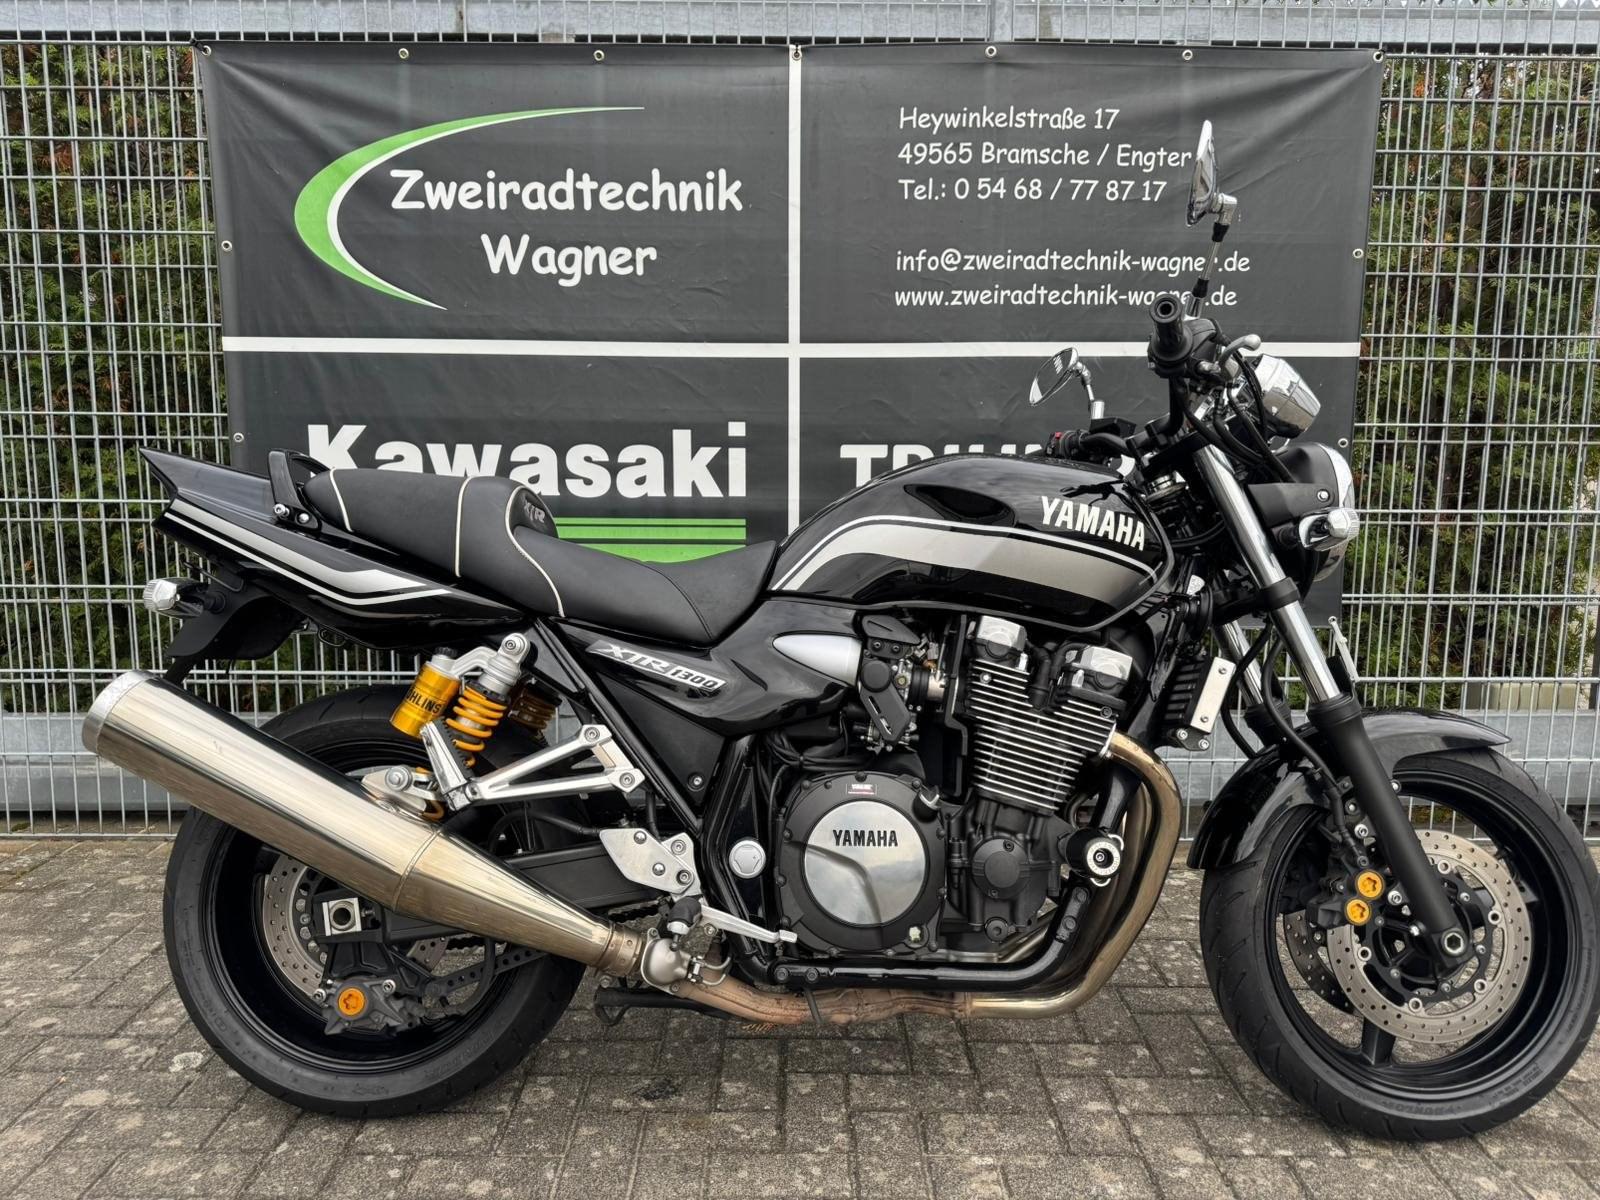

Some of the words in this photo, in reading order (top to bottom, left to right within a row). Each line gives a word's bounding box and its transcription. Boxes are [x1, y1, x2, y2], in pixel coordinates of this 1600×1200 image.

[899, 105, 1087, 135] Heywinkelstraße
[1094, 107, 1121, 130] 17
[897, 142, 973, 165] 49565
[981, 142, 1090, 166] Bramsche
[1096, 143, 1110, 166] /
[1116, 144, 1192, 172] Engter
[389, 167, 744, 212] Zweiradtechnik
[897, 177, 946, 200] Tel.:
[954, 177, 970, 200] 0
[976, 177, 1007, 200] 54
[1013, 177, 1043, 200] 68
[1049, 178, 1063, 201] /
[1069, 178, 1100, 201] 77
[1105, 179, 1136, 202] 87
[1141, 179, 1168, 202] 17
[480, 233, 658, 287] Wagner
[896, 248, 1251, 277] info@zweiradtechnik-wagne.de
[307, 421, 747, 498] Kawasaki
[1040, 495, 1147, 551] YAMAHA
[670, 668, 718, 688] 1300
[832, 829, 899, 848] YAMAHA
